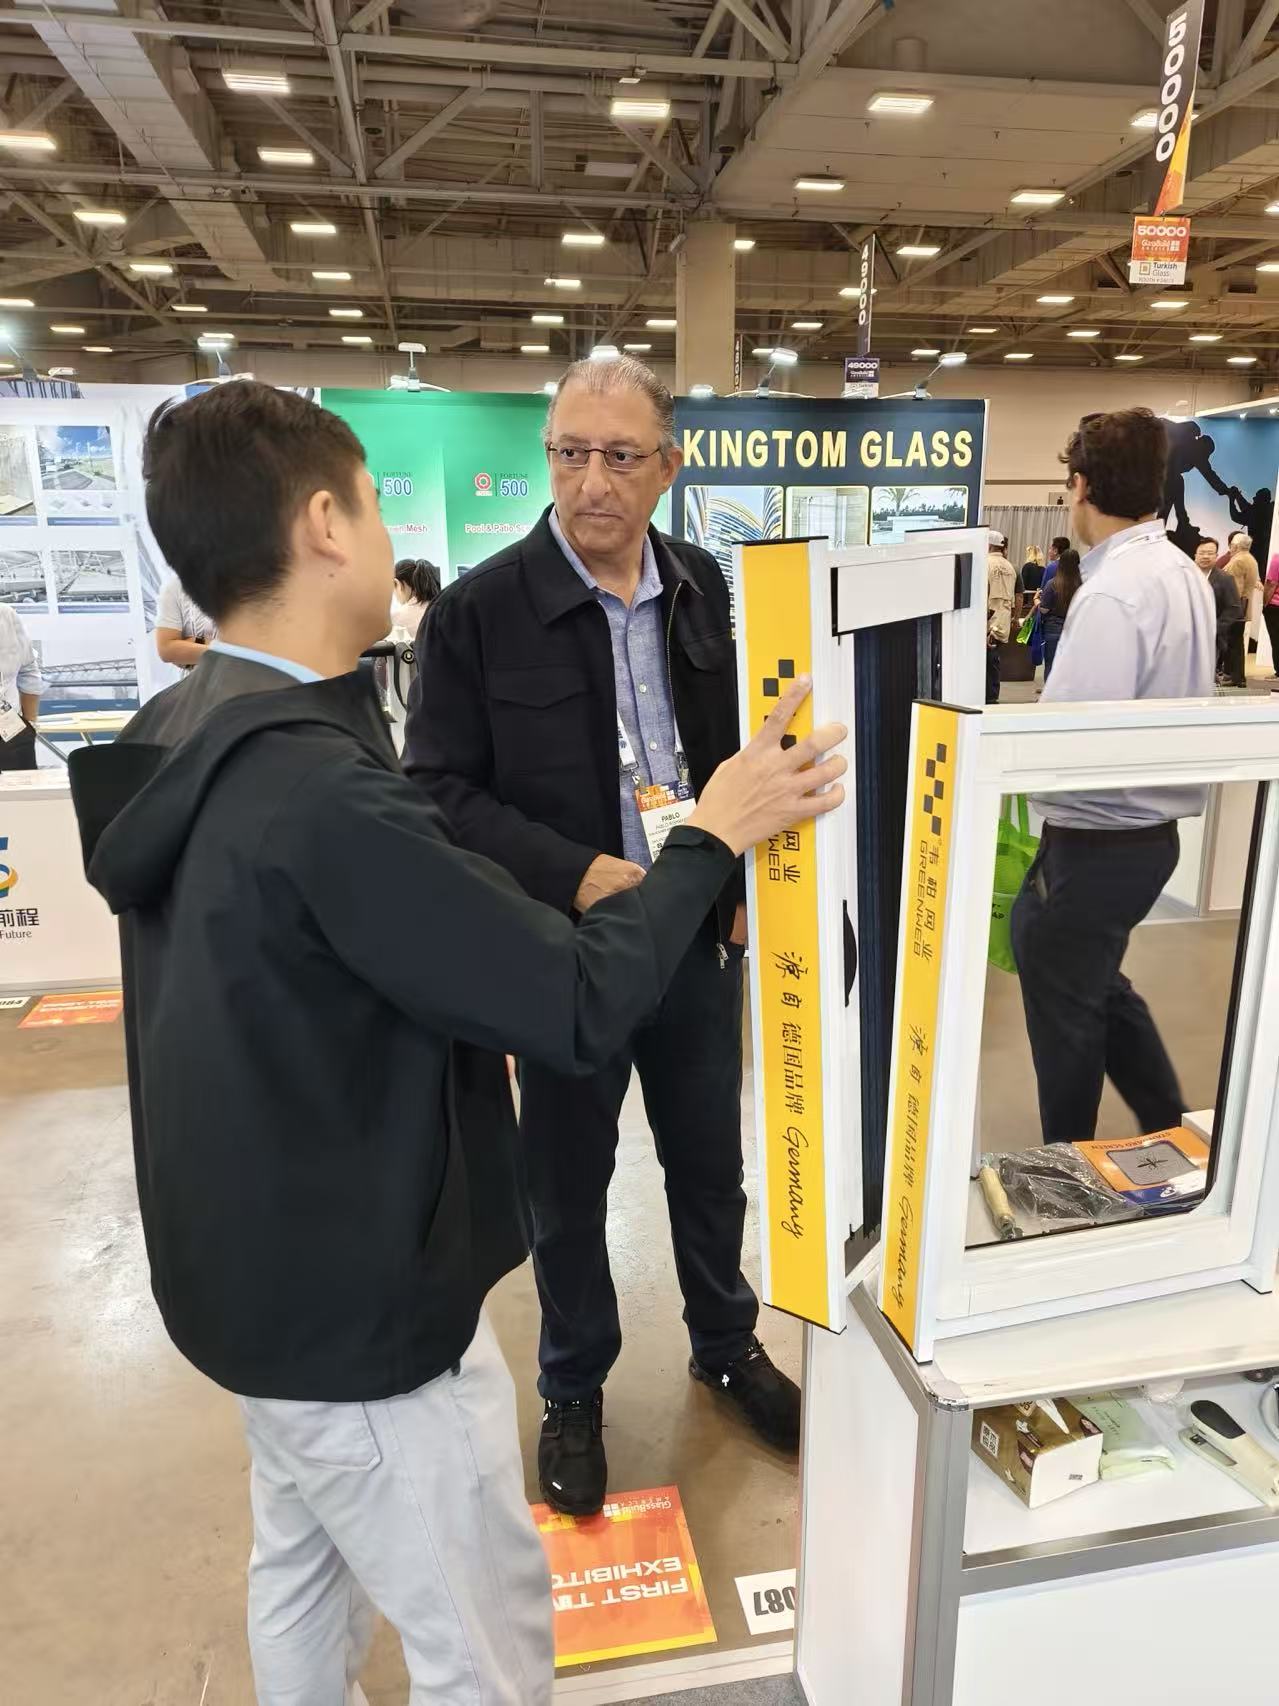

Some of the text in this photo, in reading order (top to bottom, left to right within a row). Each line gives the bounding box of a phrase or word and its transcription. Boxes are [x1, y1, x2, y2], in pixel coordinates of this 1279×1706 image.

[1156, 12, 1187, 162] 50000
[1137, 225, 1187, 237] 50000
[859, 244, 869, 325] 49000
[684, 430, 972, 468] KINGTOM GLASS
[384, 479, 412, 495] 500
[501, 480, 528, 496] 500
[406, 524, 428, 532] Mesh
[465, 524, 485, 532] Pool
[494, 524, 513, 532] Patio
[662, 812, 680, 822] PABLO
[913, 840, 928, 957] GREENWEB
[0, 930, 32, 939] Future
[781, 1126, 809, 1239] Germany
[891, 1196, 914, 1309] Germany
[621, 1500, 672, 1514] GlassBuild
[601, 1577, 689, 1605] FIRST
